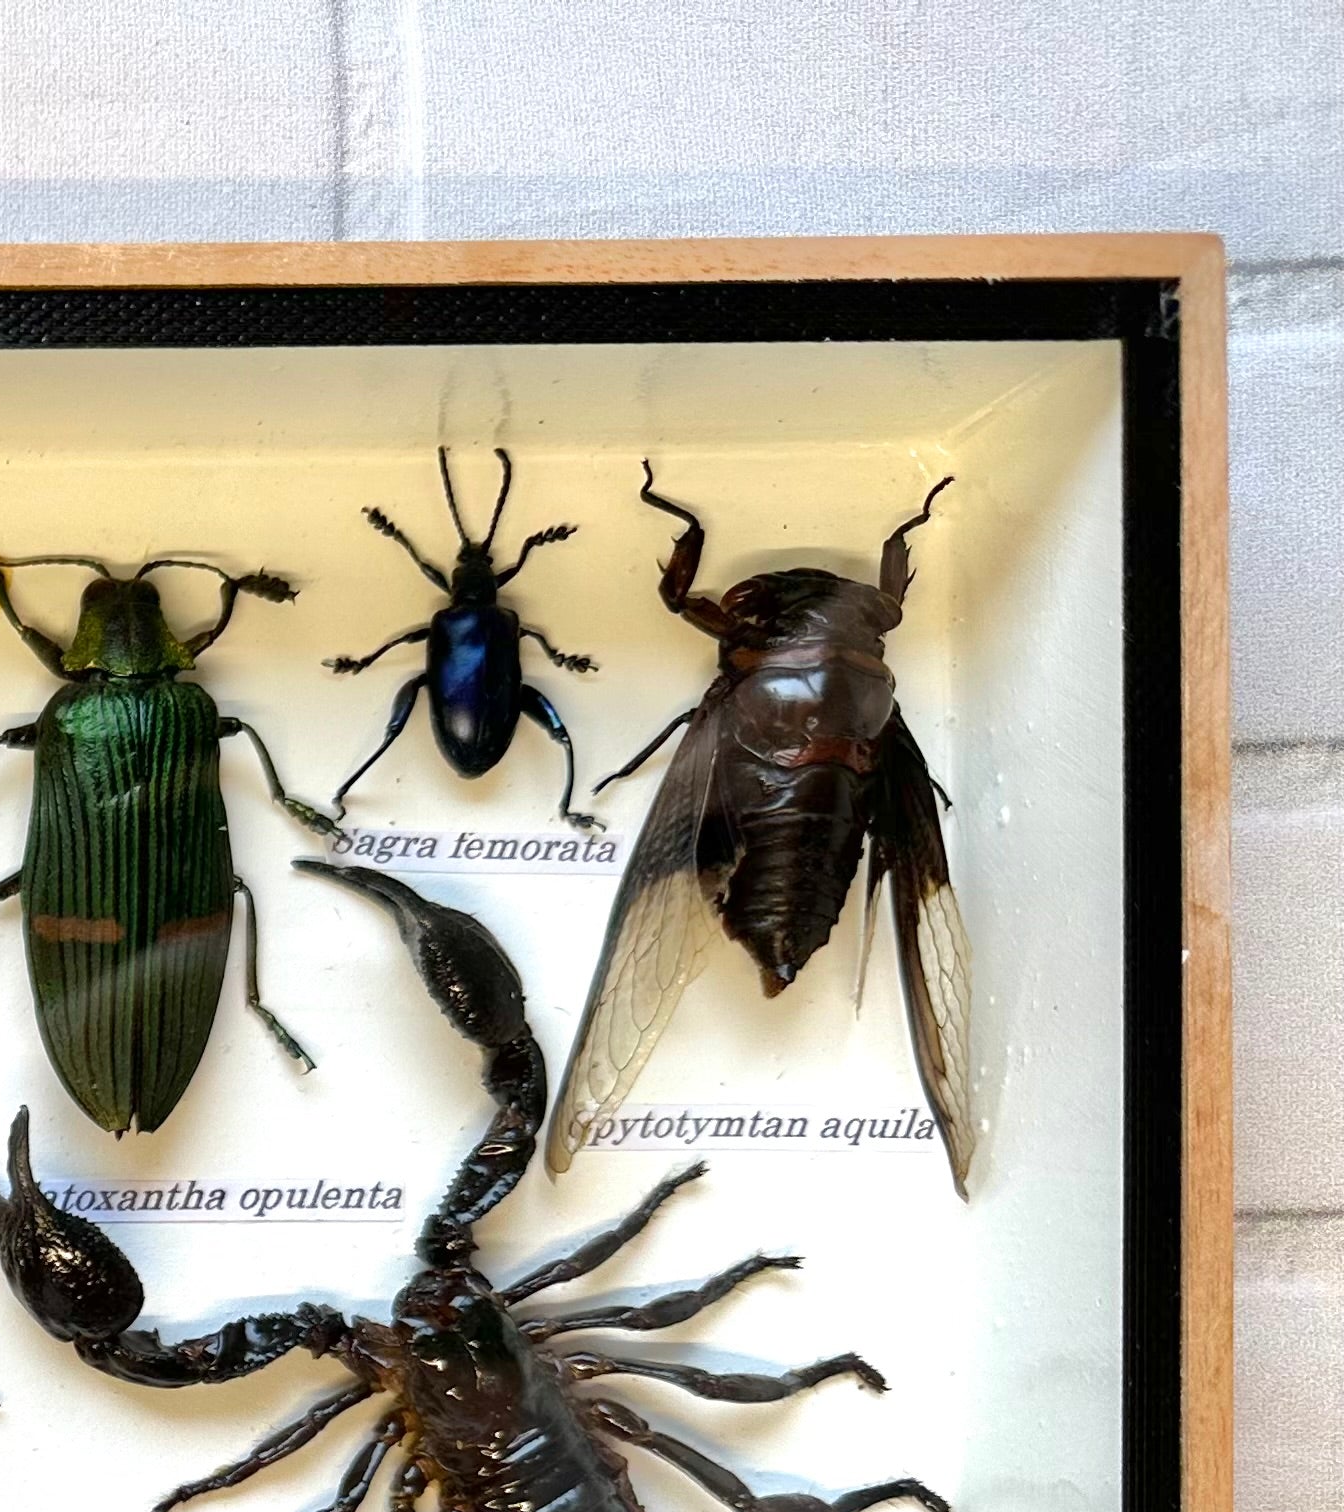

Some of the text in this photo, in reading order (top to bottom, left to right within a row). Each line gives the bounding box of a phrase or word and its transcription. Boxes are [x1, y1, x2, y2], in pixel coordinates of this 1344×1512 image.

[332, 829, 616, 865] Sagra femorata
[820, 1108, 937, 1146] aquila
[42, 1180, 403, 1216] atoxantha opulenta
